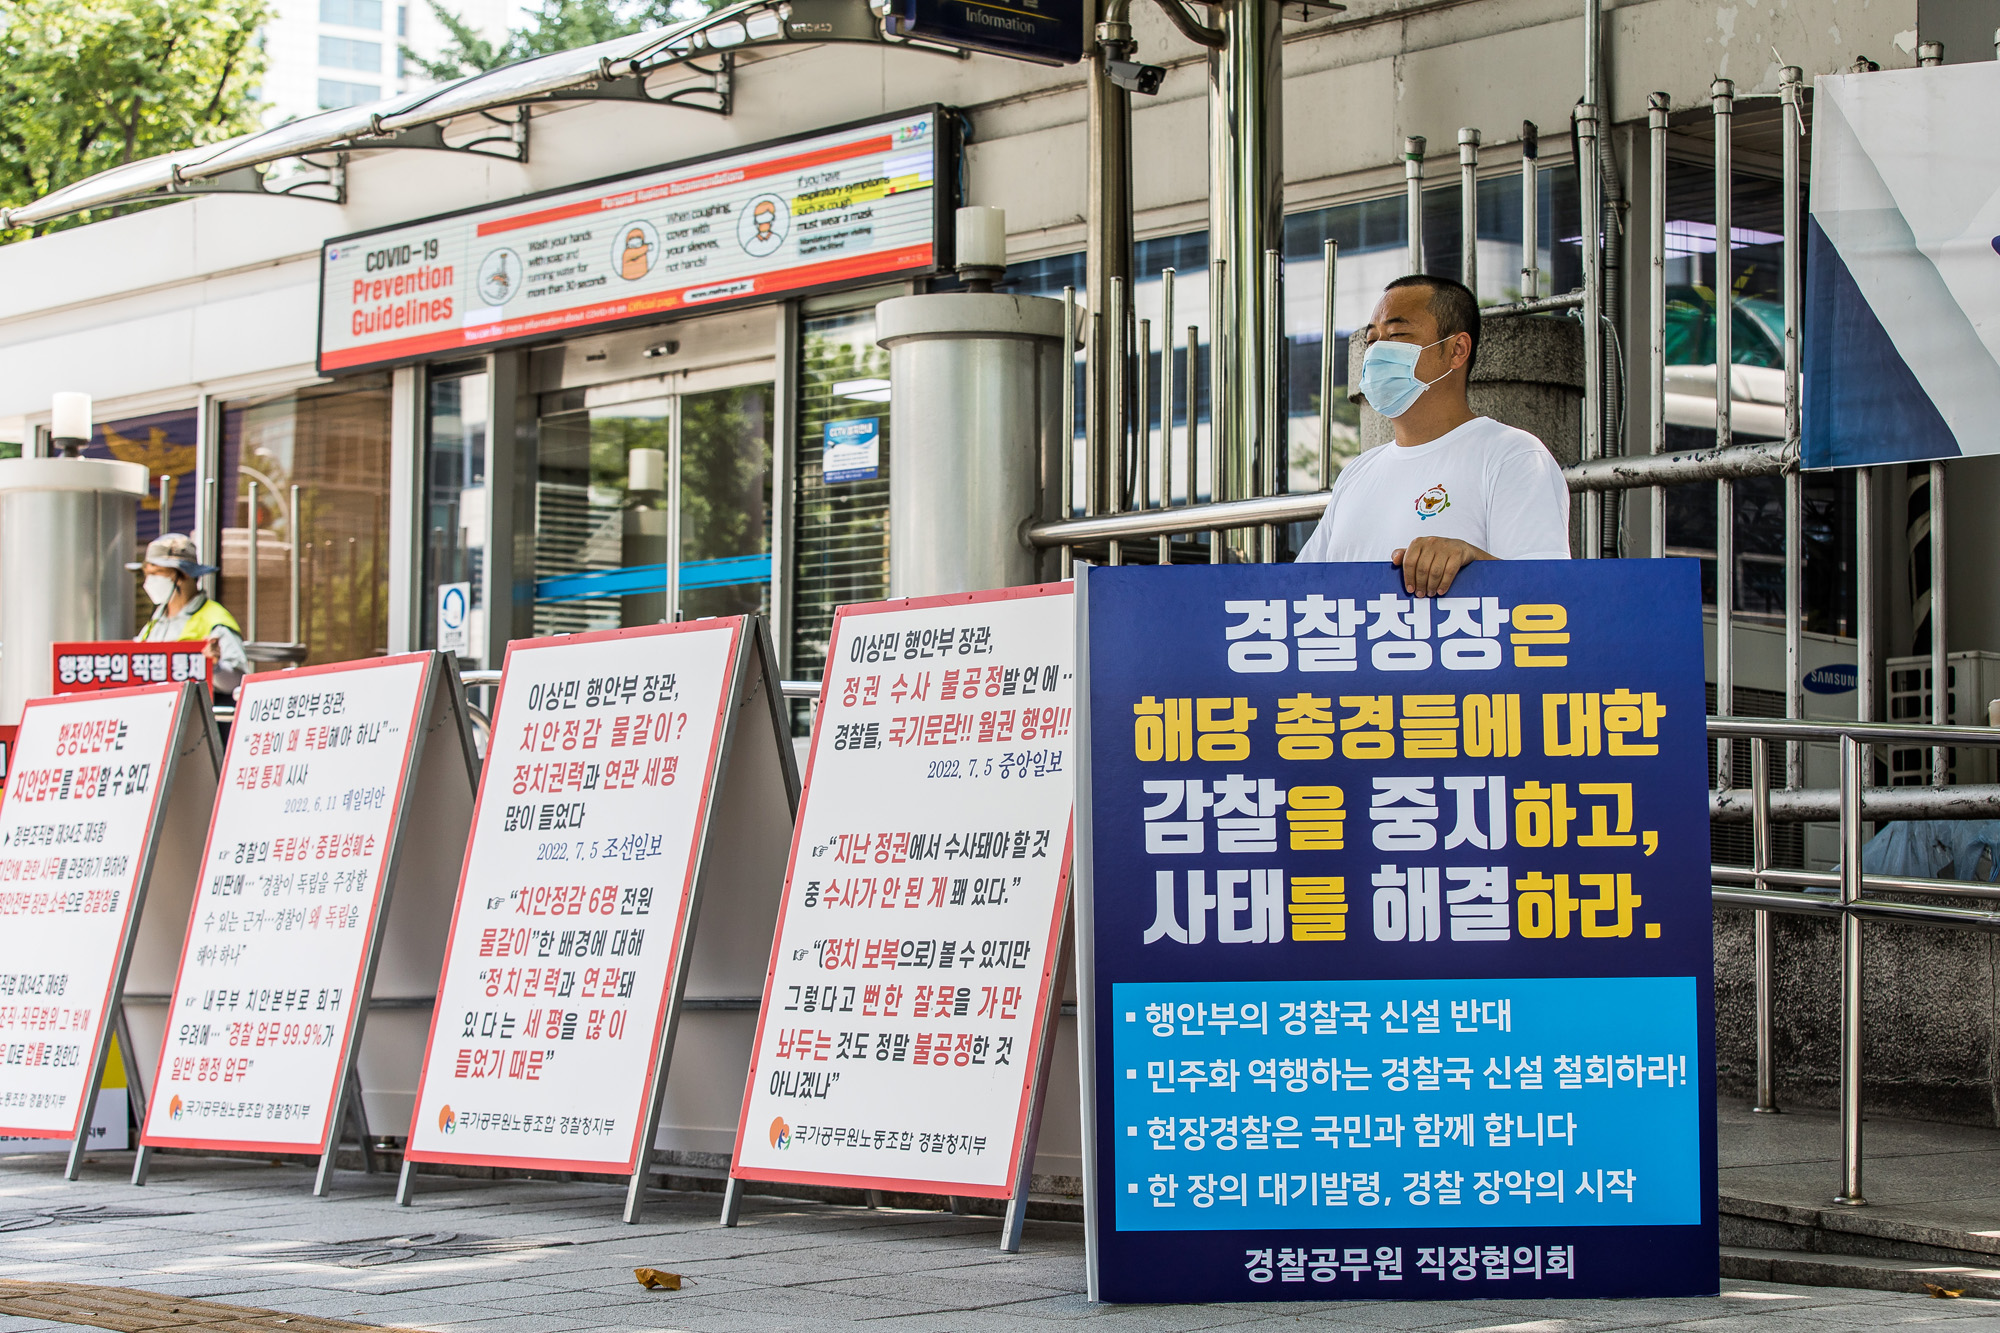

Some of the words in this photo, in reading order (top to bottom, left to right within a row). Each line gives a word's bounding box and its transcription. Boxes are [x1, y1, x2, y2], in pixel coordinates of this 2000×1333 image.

[966, 8, 1035, 34] Information
[366, 239, 438, 272] COVID-19
[353, 265, 453, 304] Prevention
[352, 297, 453, 336] Guidelines
[851, 632, 900, 663] 이상민
[904, 628, 955, 659] 행안부
[958, 626, 993, 655] 장관,
[1224, 593, 1570, 674] 경찰청장은
[58, 654, 128, 684] 행정부의
[132, 653, 167, 682] 직접
[171, 652, 206, 681] 통제
[1811, 670, 1858, 686] SAMSUN
[529, 680, 580, 711] 이상민
[586, 675, 638, 707] 행안부
[643, 673, 678, 702] 장관,
[843, 675, 881, 707] 정권
[891, 671, 930, 703] 수사
[250, 697, 284, 722] 이상민
[286, 693, 321, 719] 행안부
[322, 692, 345, 715] 장관,
[56, 719, 128, 756] 행정안전부는
[287, 729, 300, 751] 왜
[305, 725, 352, 750] 독립해야
[520, 718, 602, 752] 치안정감
[611, 712, 687, 747] 물갈이?
[835, 723, 881, 750] 경찰들,
[889, 713, 974, 747] 국기문란!!
[978, 710, 1016, 743] 월권
[1021, 706, 1071, 740] 행위!!
[1134, 695, 1258, 762] 해당
[1274, 692, 1522, 761] 총경들에
[1542, 688, 1666, 757] 대한
[513, 761, 600, 795] 정치권력과
[604, 759, 639, 790] 연관
[642, 756, 679, 786] 세평
[927, 760, 961, 779] 2022.
[969, 759, 978, 778] 7.
[984, 758, 993, 776] 5
[999, 749, 1062, 779] 중앙일보
[13, 768, 73, 802] 치안업무를
[74, 766, 111, 799] 관장할
[113, 766, 124, 796] 수
[125, 763, 150, 795] 없다.
[342, 787, 386, 811] 데일리안
[1142, 774, 1346, 854] 감찰을
[1369, 775, 1659, 856] 중지하고,
[504, 805, 536, 832] 많이
[538, 802, 585, 830] 들었다
[235, 842, 269, 864] 경찰의
[537, 843, 568, 861] 2022.
[576, 842, 584, 861] 7.
[590, 842, 599, 858] 5
[602, 833, 662, 861] 조선일보
[875, 832, 942, 864] 정권에서
[944, 831, 1010, 860] 수사돼야
[1012, 830, 1030, 858] 할
[1032, 830, 1050, 858] 것
[589, 885, 618, 915] 6명
[621, 887, 653, 915] 전원
[805, 881, 820, 907] 중
[823, 878, 877, 909] 수사가
[881, 877, 901, 908] 안
[904, 877, 924, 908] 된
[927, 877, 948, 908] 게
[950, 879, 968, 905] 꽤
[1143, 868, 1348, 945] 사태를
[1371, 864, 1661, 942] 해결하라.
[558, 930, 608, 957] 배경에
[611, 928, 645, 956] 대해
[862, 939, 936, 970] 보복으로)
[939, 941, 956, 968] 볼
[959, 941, 975, 968] 수
[979, 940, 1031, 969] 있지만
[581, 968, 636, 998] 연관돼
[203, 990, 240, 1011] 내무부
[246, 989, 310, 1011] 치안본부로
[316, 988, 342, 1011] 회귀
[784, 986, 856, 1012] 그렇다고
[862, 984, 903, 1016] 뻔한
[913, 985, 970, 1018] 잘못을
[977, 986, 1022, 1019] 가만
[462, 1012, 515, 1039] 있다는
[523, 1009, 578, 1040] 세평을
[586, 1010, 627, 1040] 많이
[1145, 1002, 1269, 1036] 행안부의
[1278, 1000, 1371, 1035] 경찰국
[1380, 1000, 1440, 1034] 신설
[1450, 998, 1512, 1034] 반대
[455, 1049, 505, 1079] 들었기
[776, 1029, 831, 1061] 놔두는
[836, 1032, 869, 1059] 것도
[876, 1033, 910, 1061] 정말
[913, 1033, 990, 1067] 불공정한
[995, 1037, 1013, 1065] 것
[171, 1057, 195, 1080] 일반
[198, 1057, 221, 1081] 행정
[770, 1071, 840, 1099] 아니겠나”
[1148, 1059, 1240, 1093] 민주화
[1248, 1058, 1372, 1093] 역행하는
[1381, 1056, 1474, 1092] 경찰국
[1483, 1055, 1544, 1090] 신설
[1552, 1054, 1688, 1089] 철회하라!
[186, 1101, 263, 1118] 국가공무원노동조합
[267, 1104, 310, 1120] 경찰청지부
[460, 1112, 555, 1133] 국가공무원노동조합
[560, 1117, 615, 1136] 경찰청지부
[795, 1126, 914, 1151] 국가공무원노동조합
[919, 1133, 986, 1155] 경찰청지부
[1147, 1114, 1302, 1151] 현장경찰은
[1311, 1114, 1405, 1149] 국민과
[1414, 1112, 1475, 1148] 함께
[1484, 1112, 1577, 1147] 합니다
[1148, 1172, 1178, 1207] 한
[1188, 1172, 1247, 1207] 장의
[1258, 1170, 1391, 1207] 대기발령,
[1402, 1170, 1464, 1205] 경찰
[1473, 1169, 1564, 1205] 장악의
[1575, 1168, 1636, 1204] 시작
[1244, 1246, 1402, 1282] 경찰공무원
[1415, 1244, 1575, 1280] 직장협의회
